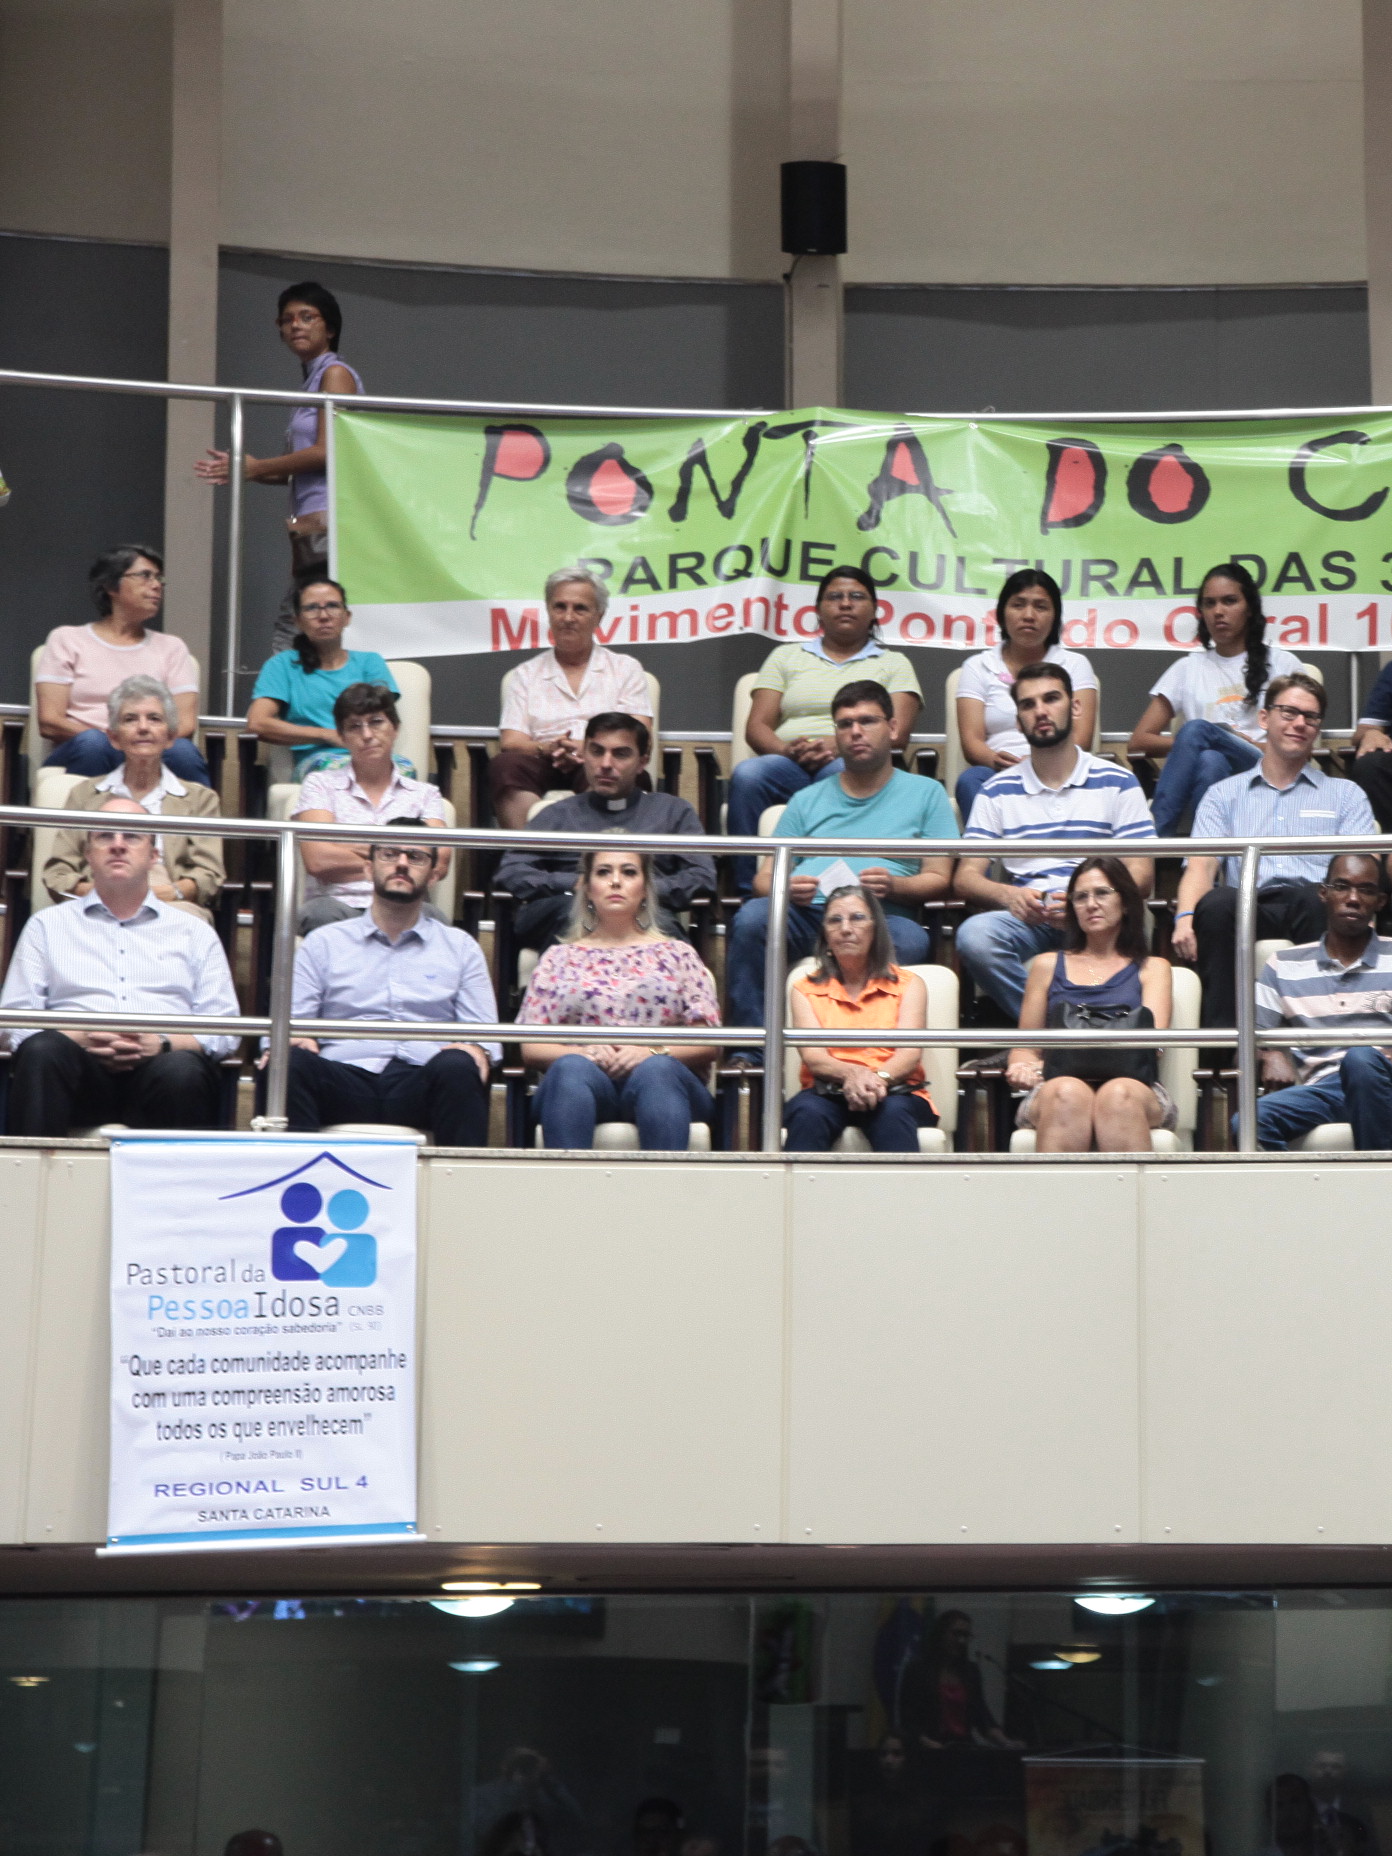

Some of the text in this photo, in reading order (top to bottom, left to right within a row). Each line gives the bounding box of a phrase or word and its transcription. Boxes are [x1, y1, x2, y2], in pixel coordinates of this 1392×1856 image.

[470, 420, 958, 540] PONTA
[1041, 437, 1212, 535] DO
[578, 537, 838, 595] PARQUE
[861, 546, 1201, 597] CULTURAL
[1230, 550, 1357, 593] DAS
[490, 591, 825, 652] Mvimento
[1061, 608, 1140, 648] do
[127, 1259, 265, 1285] Pastoral da
[167, 1353, 206, 1375] cada
[211, 1349, 311, 1374] comunidade
[315, 1348, 407, 1375] acompanhe
[132, 1382, 396, 1409] com uma compreensão amorosa
[157, 1419, 203, 1441] todos
[208, 1422, 227, 1438] os
[233, 1421, 262, 1443] que
[154, 1476, 369, 1497] REGIONAL SUL 4
[198, 1506, 330, 1522] SANTA CATARINA
